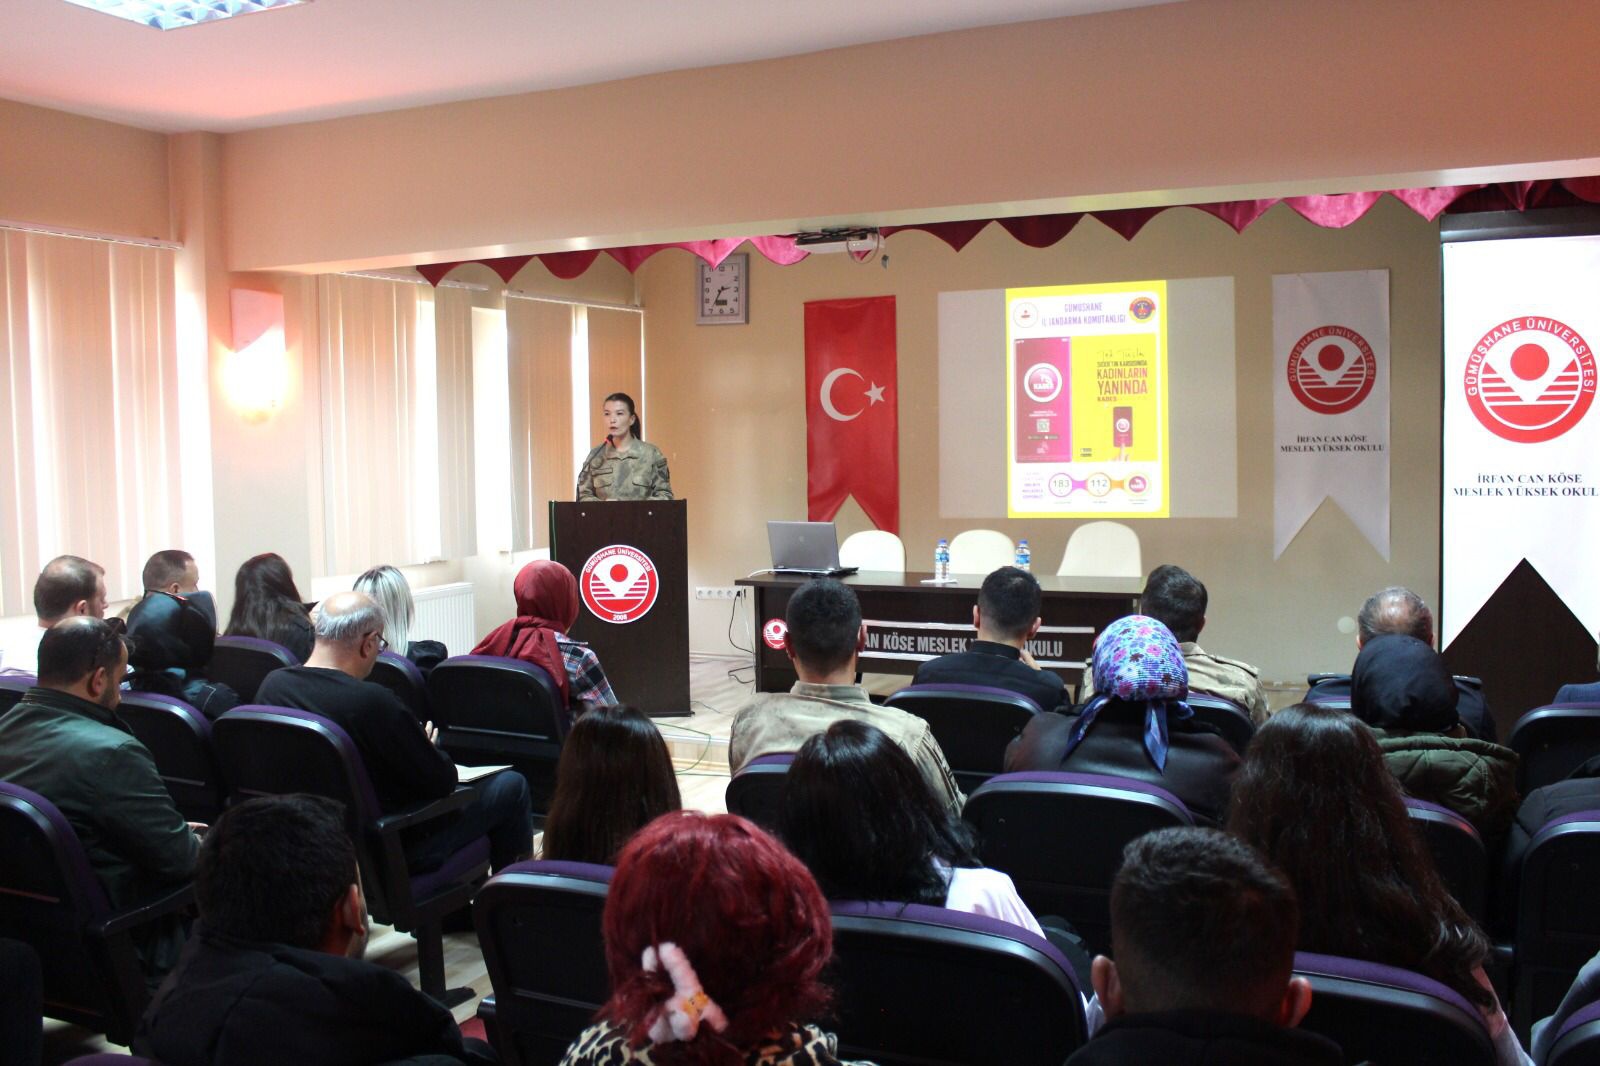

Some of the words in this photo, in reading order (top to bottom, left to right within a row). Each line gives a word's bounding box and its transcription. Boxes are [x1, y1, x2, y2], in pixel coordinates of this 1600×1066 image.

[1097, 367, 1148, 379] KADINLARIN
[1097, 379, 1148, 395] YANINDA
[1297, 434, 1323, 443] İRFAN
[1324, 435, 1342, 443] CAN
[1344, 433, 1368, 443] KÖSE
[1280, 444, 1315, 452] MESLEK
[1317, 443, 1352, 452] YÜKSEK
[1353, 443, 1384, 452] OKULU
[1477, 472, 1514, 483] İRFAN
[1517, 474, 1544, 483] CAN
[1548, 471, 1583, 483] KÖSE
[1053, 479, 1070, 488] 183
[1091, 479, 1108, 488] 112
[1453, 487, 1507, 497] MESLEK
[1507, 485, 1558, 497] YÜKSEK
[1562, 487, 1600, 497] OKUL
[585, 549, 616, 573] GÜMÜŞHANE
[617, 548, 652, 572] ÜNİVERSİTESİ
[865, 632, 879, 648] AN
[883, 631, 915, 652] KÖSE
[917, 636, 968, 654] MESLEK
